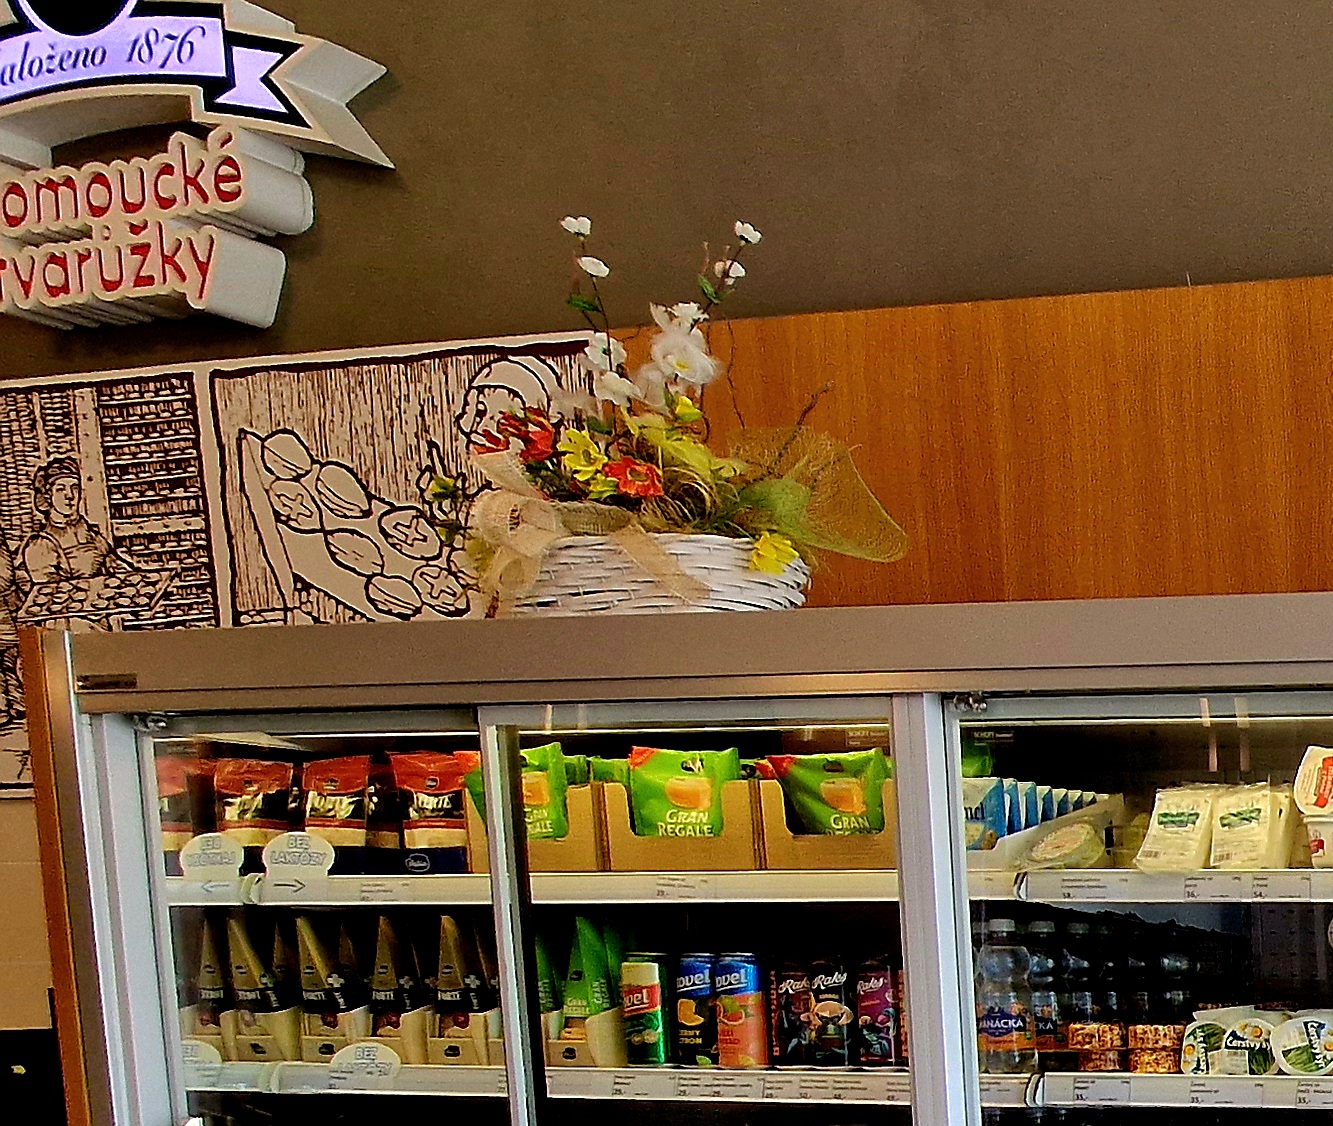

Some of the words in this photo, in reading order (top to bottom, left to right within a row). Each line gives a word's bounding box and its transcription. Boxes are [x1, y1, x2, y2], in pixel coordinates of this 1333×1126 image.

[127, 25, 206, 66] 1876
[666, 810, 709, 825] GRAN
[830, 814, 869, 830] GRAN
[658, 823, 713, 837] REGALE
[779, 977, 811, 994] Rak
